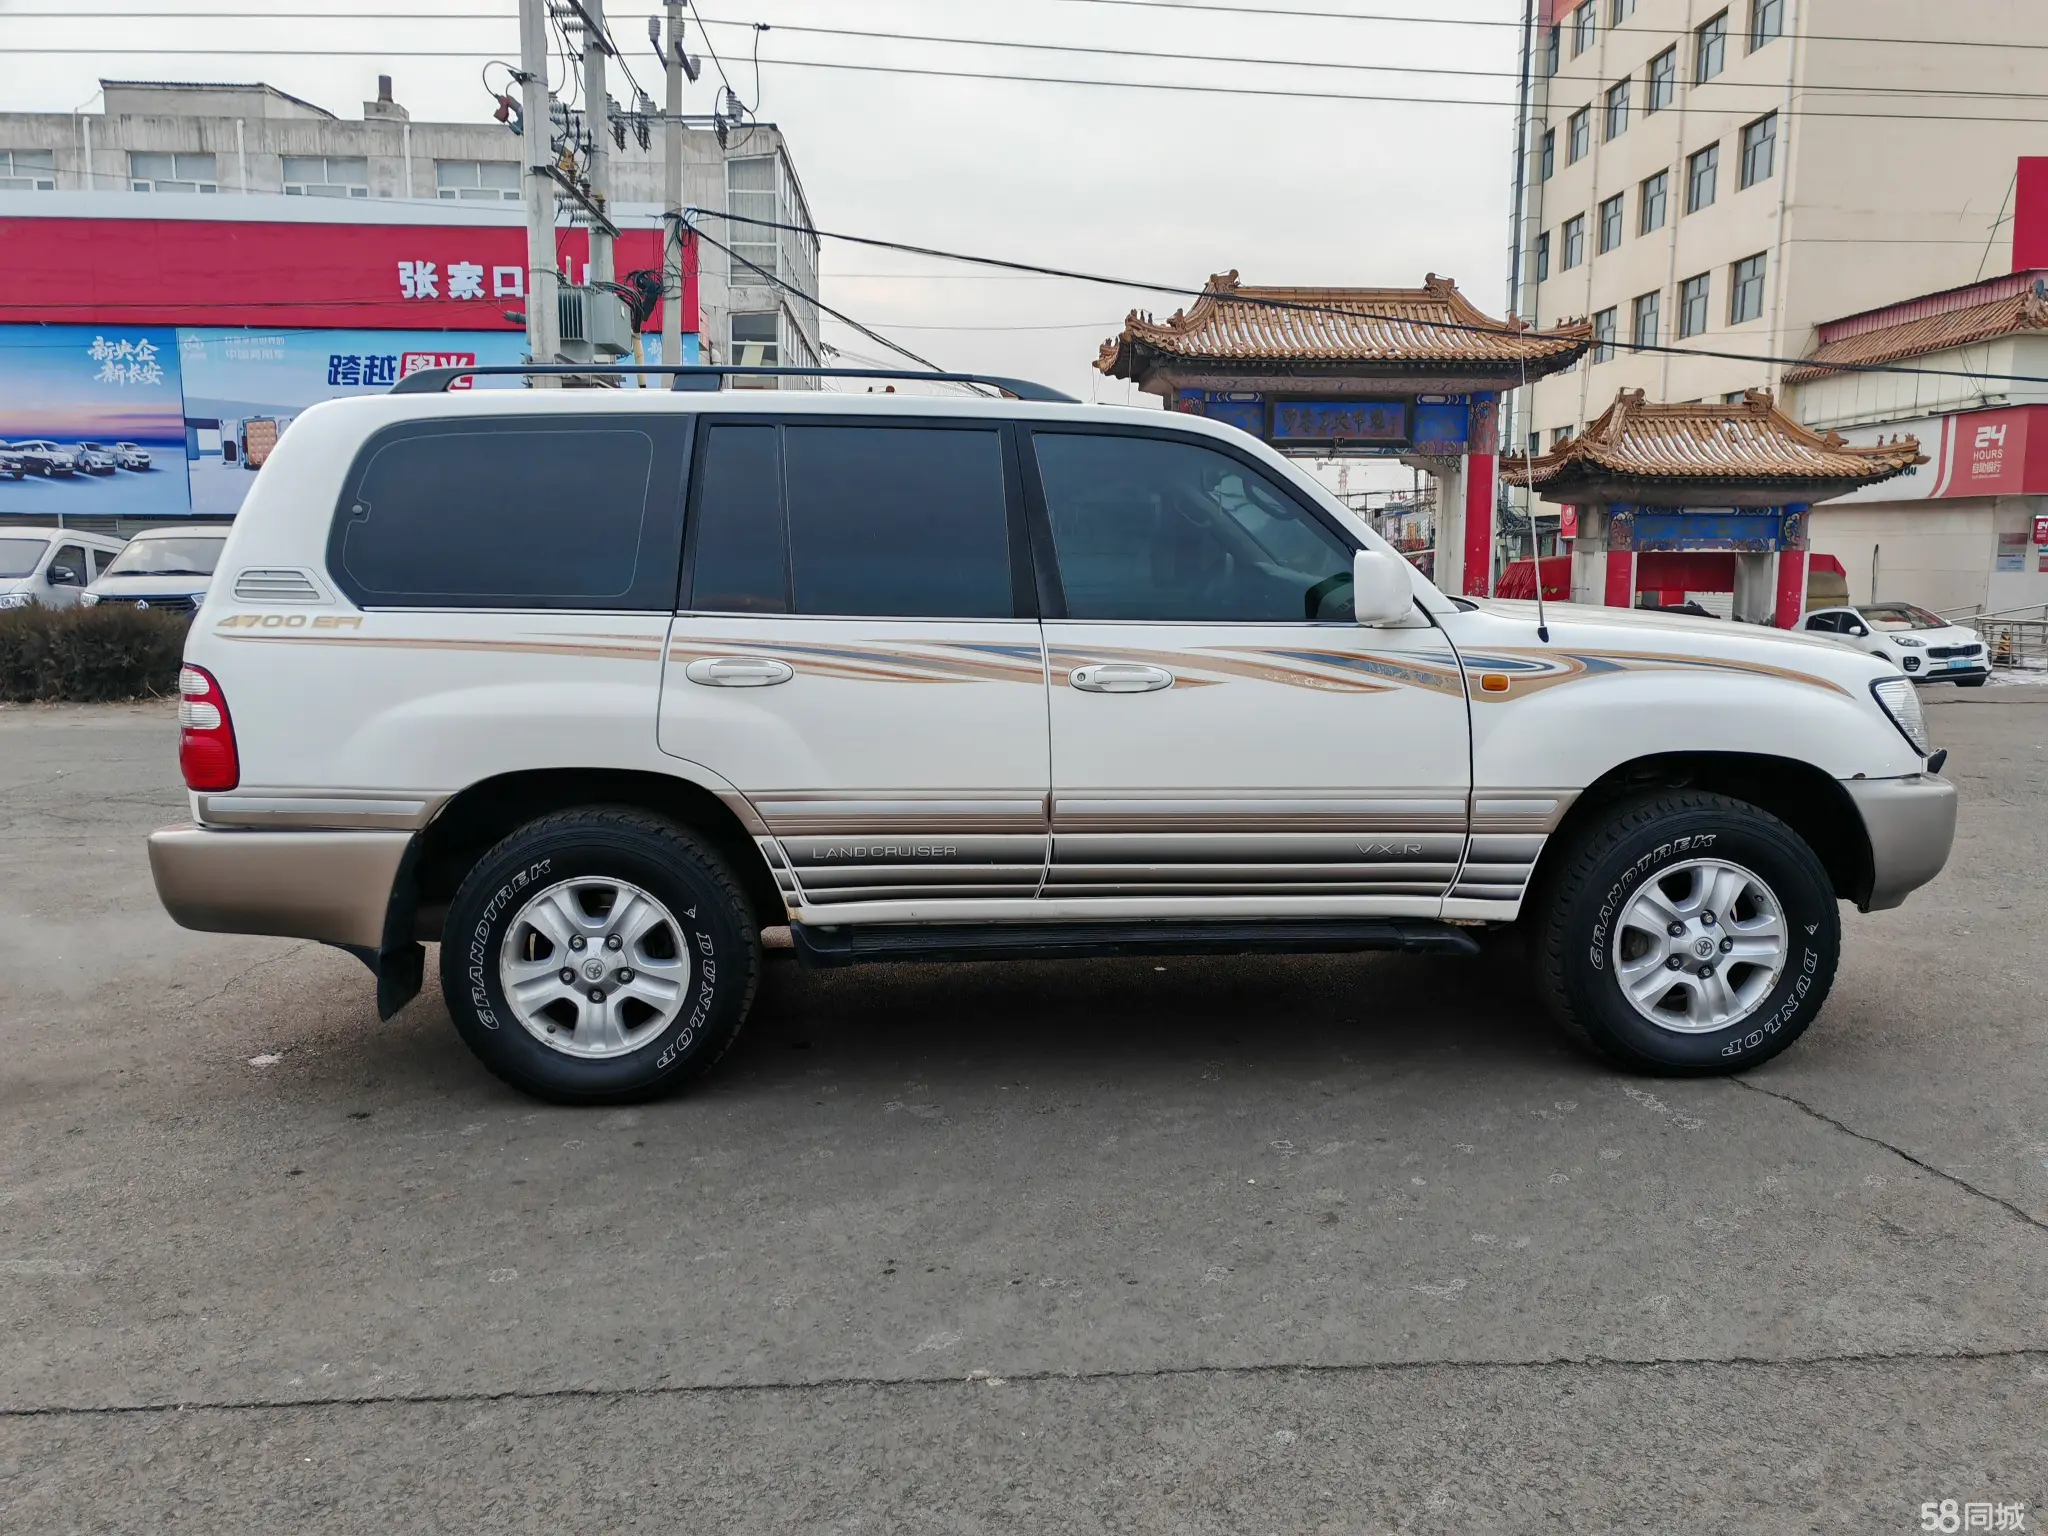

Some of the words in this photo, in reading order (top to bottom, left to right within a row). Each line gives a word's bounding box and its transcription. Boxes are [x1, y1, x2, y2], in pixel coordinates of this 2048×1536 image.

[87, 336, 160, 362] 新央企
[94, 361, 164, 387] 新长安
[1974, 424, 2007, 448] 24
[1972, 461, 2002, 474] 自助银行
[1973, 449, 2003, 460] HOURS
[216, 615, 307, 628] 4700
[311, 616, 363, 629] EFI
[812, 847, 867, 859] LAND
[870, 846, 957, 857] CRUISER
[1590, 834, 1716, 970] GRANDTREK
[469, 858, 551, 1030] GRANDTREK
[656, 931, 716, 1068] DUNLOP
[1721, 948, 1818, 1057] DUNLOP
